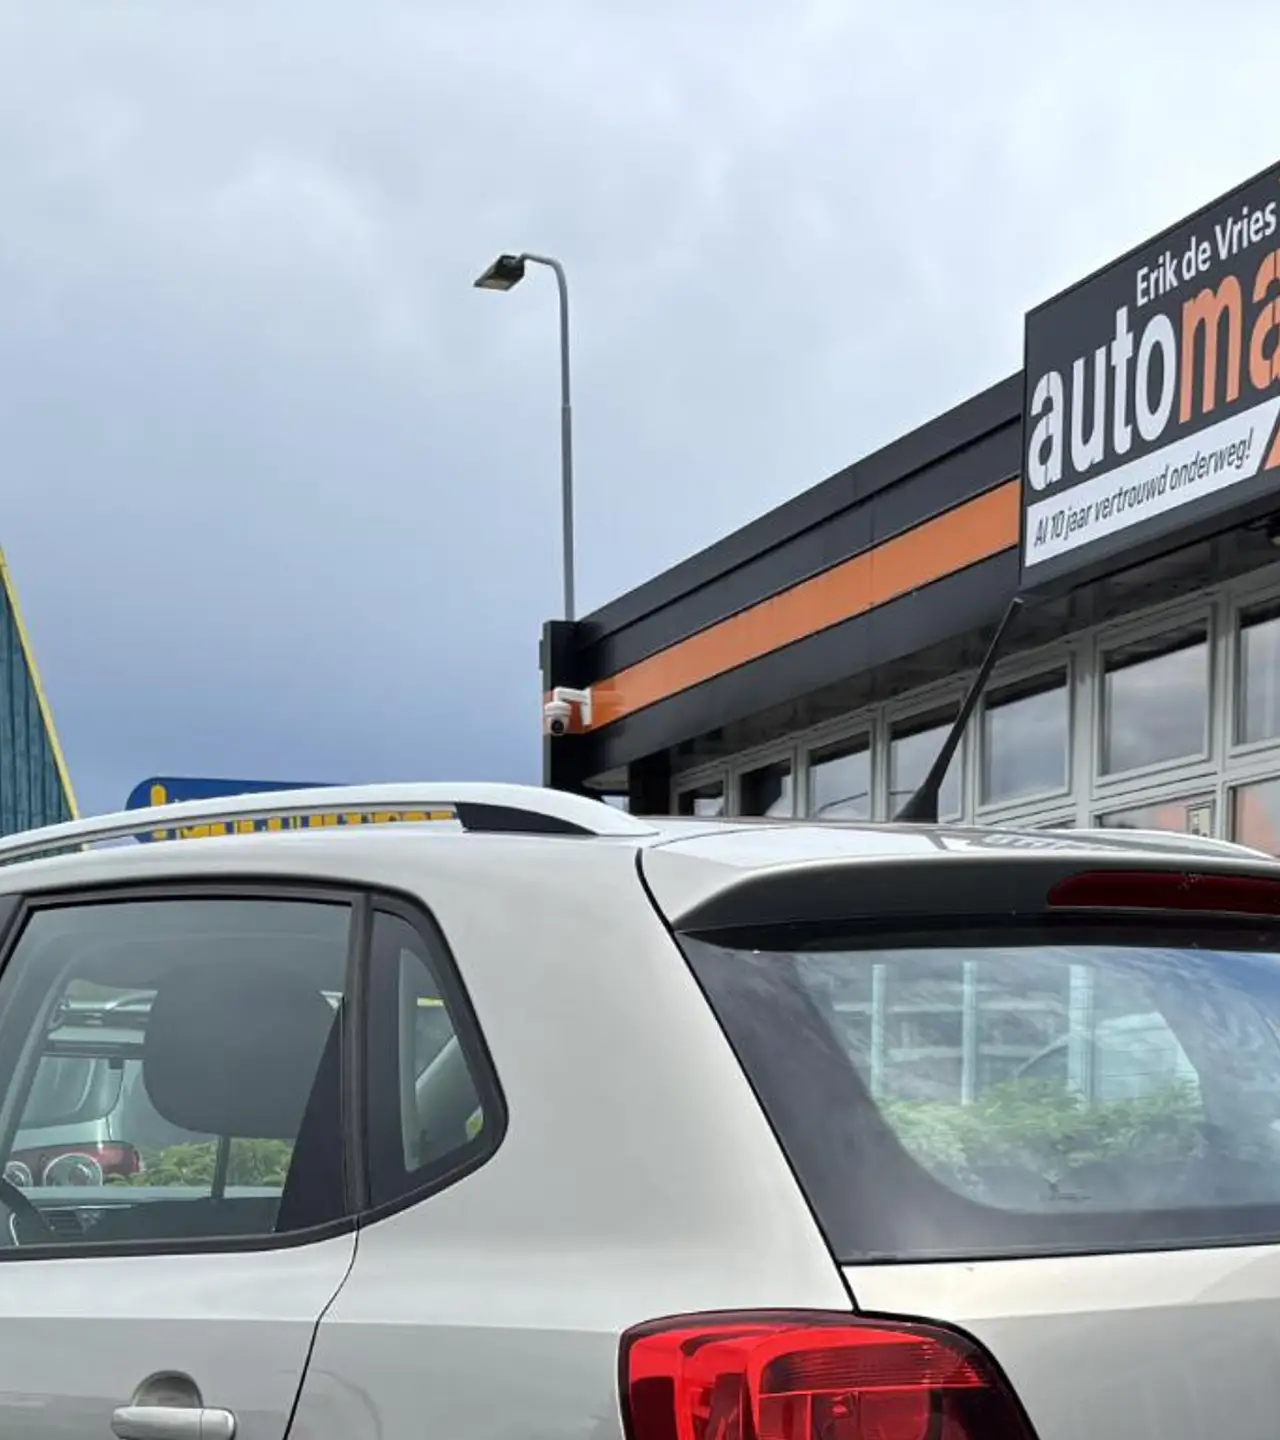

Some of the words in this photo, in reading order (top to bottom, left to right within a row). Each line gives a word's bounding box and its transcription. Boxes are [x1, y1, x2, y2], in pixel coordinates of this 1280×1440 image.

[1136, 251, 1178, 307] Erik
[1182, 236, 1211, 281] de
[1214, 201, 1277, 260] Vries
[1034, 515, 1049, 548] Al
[1051, 509, 1065, 540] 10
[1063, 504, 1093, 540] jaar
[1094, 464, 1169, 522] vertrouwd
[1170, 427, 1254, 490] onderweg!
